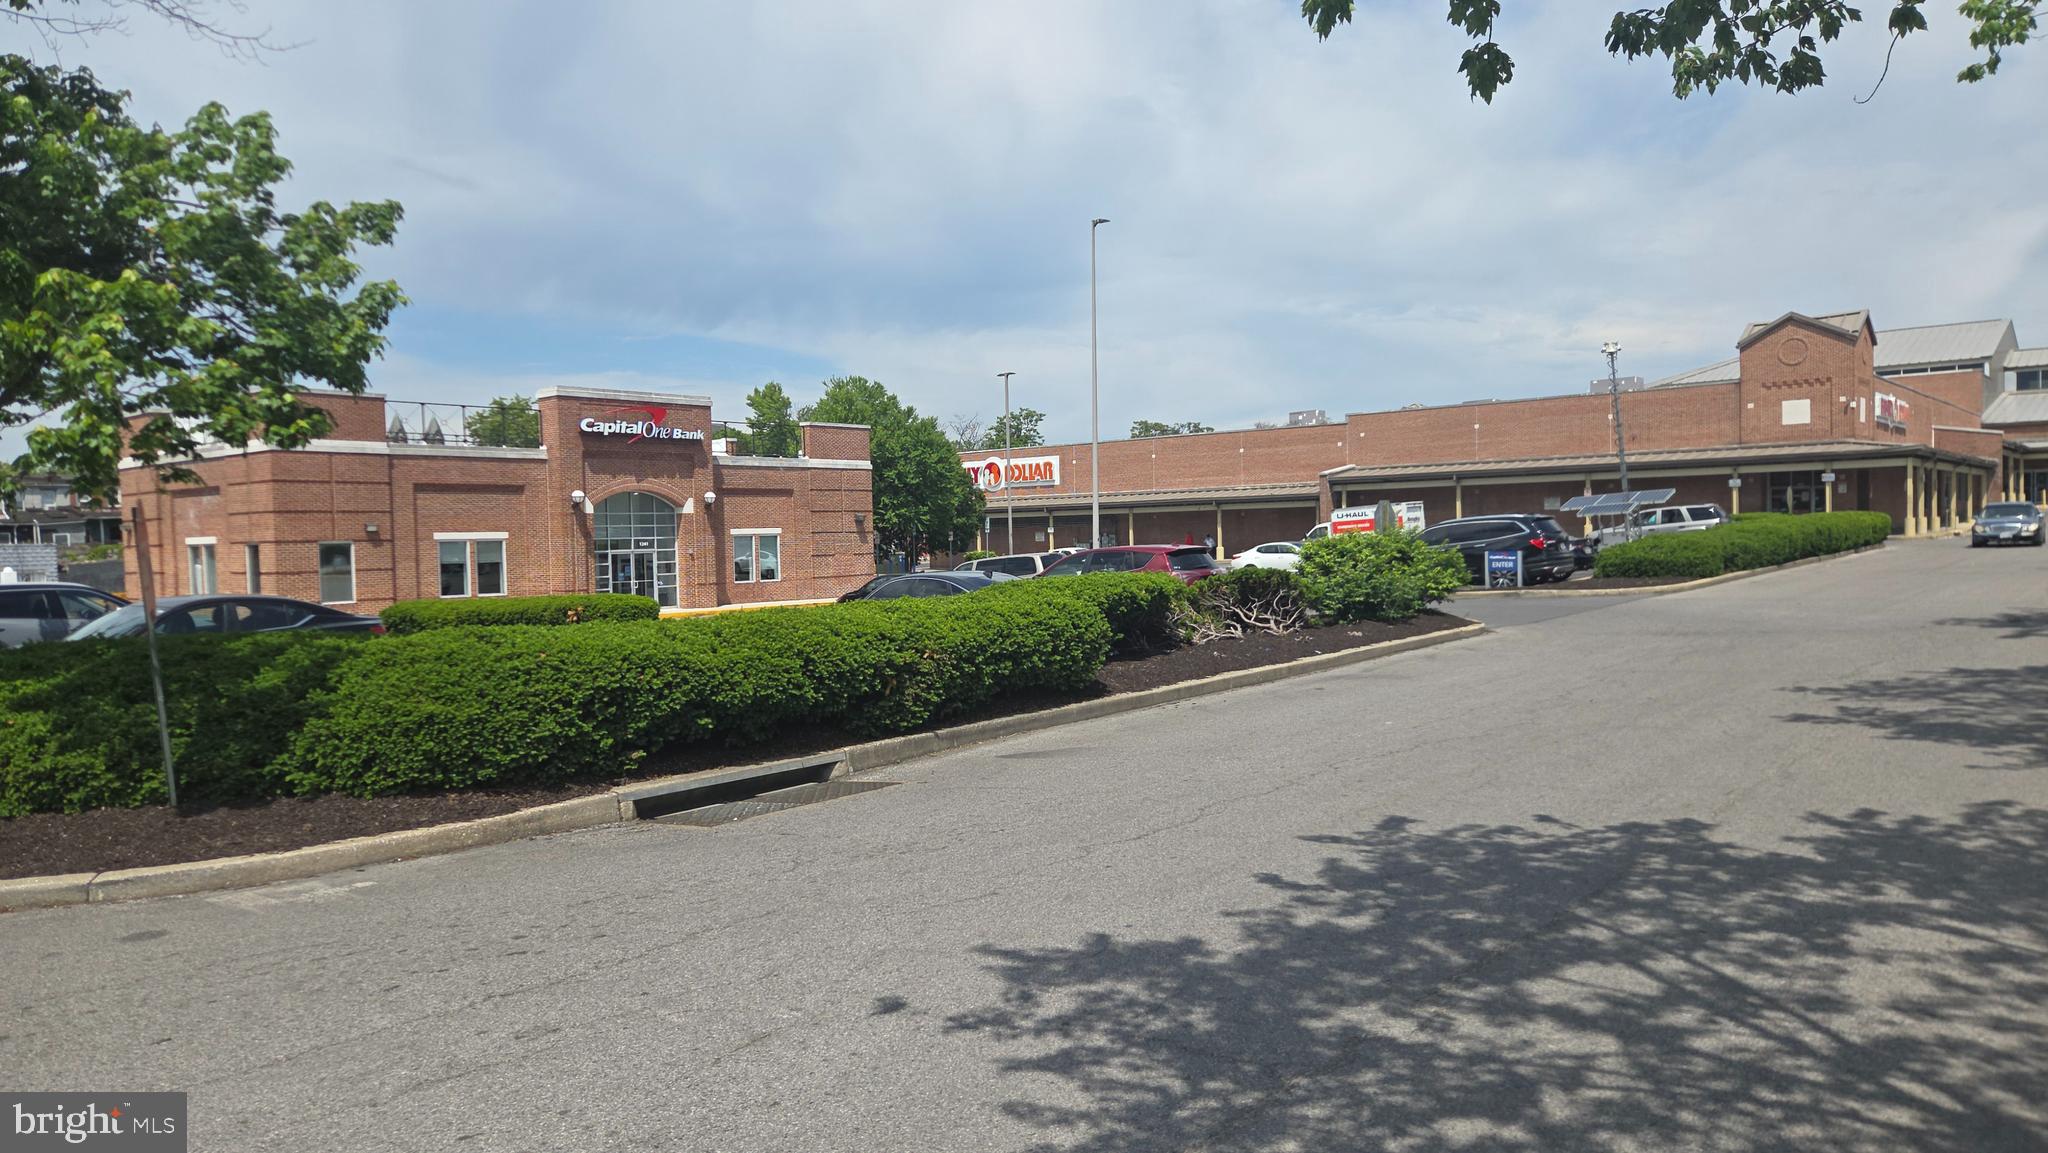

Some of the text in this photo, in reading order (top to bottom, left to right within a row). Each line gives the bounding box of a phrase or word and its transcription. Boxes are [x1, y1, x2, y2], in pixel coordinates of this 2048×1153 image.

[672, 428, 705, 440] Bank
[1004, 461, 1053, 483] DOLLAR
[1336, 511, 1369, 519] U-HAUL
